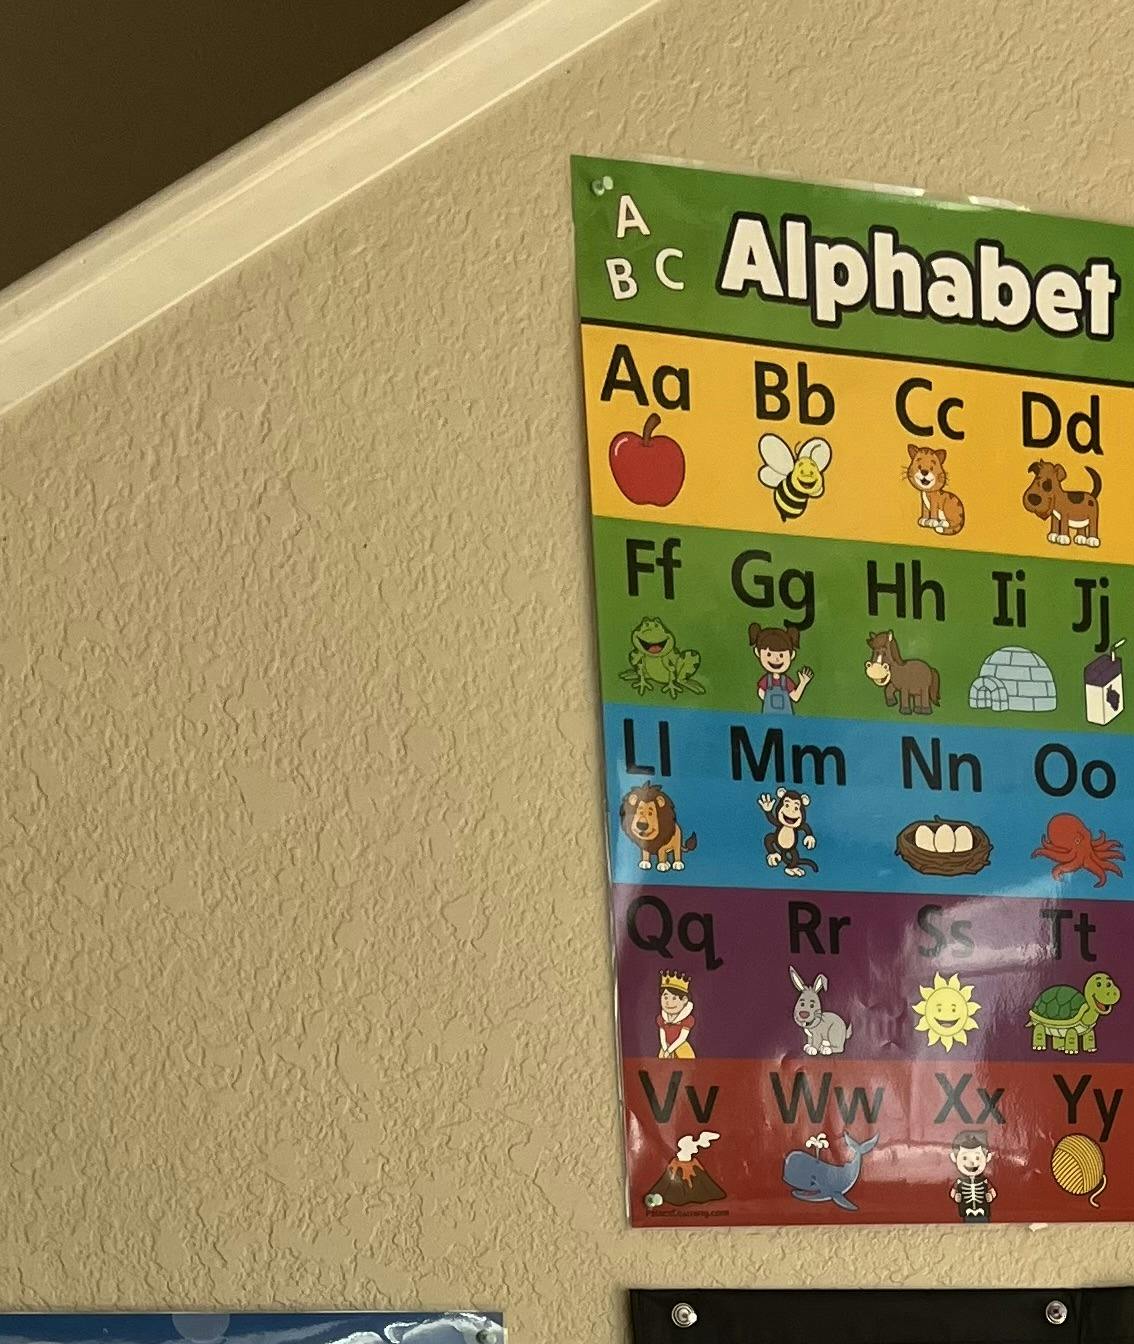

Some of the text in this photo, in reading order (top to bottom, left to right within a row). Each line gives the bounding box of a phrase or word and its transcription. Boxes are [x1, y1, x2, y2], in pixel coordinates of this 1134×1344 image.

[616, 195, 650, 238] A
[605, 248, 684, 299] B C
[719, 213, 1120, 338] Alphabet
[599, 344, 691, 411] Aa
[754, 361, 835, 425] Bb
[895, 378, 966, 440] Cc
[1021, 391, 1103, 455] Dd
[625, 538, 682, 599] Ff
[731, 550, 815, 630] Gg
[866, 559, 945, 620] Hh
[992, 571, 1026, 627] Ii
[1072, 577, 1111, 651] Jj
[623, 718, 671, 776] Ll
[730, 725, 846, 785] Mm
[902, 736, 982, 793] Nn
[1034, 743, 1116, 798] Oo
[626, 895, 722, 970] Qq
[789, 902, 851, 955] Rr
[917, 907, 974, 958] Ss
[1042, 909, 1097, 960] Tt
[638, 1071, 719, 1124] Vv
[770, 1072, 882, 1124] Ww
[935, 1073, 1006, 1124] Xx
[1053, 1074, 1123, 1142] Yy
